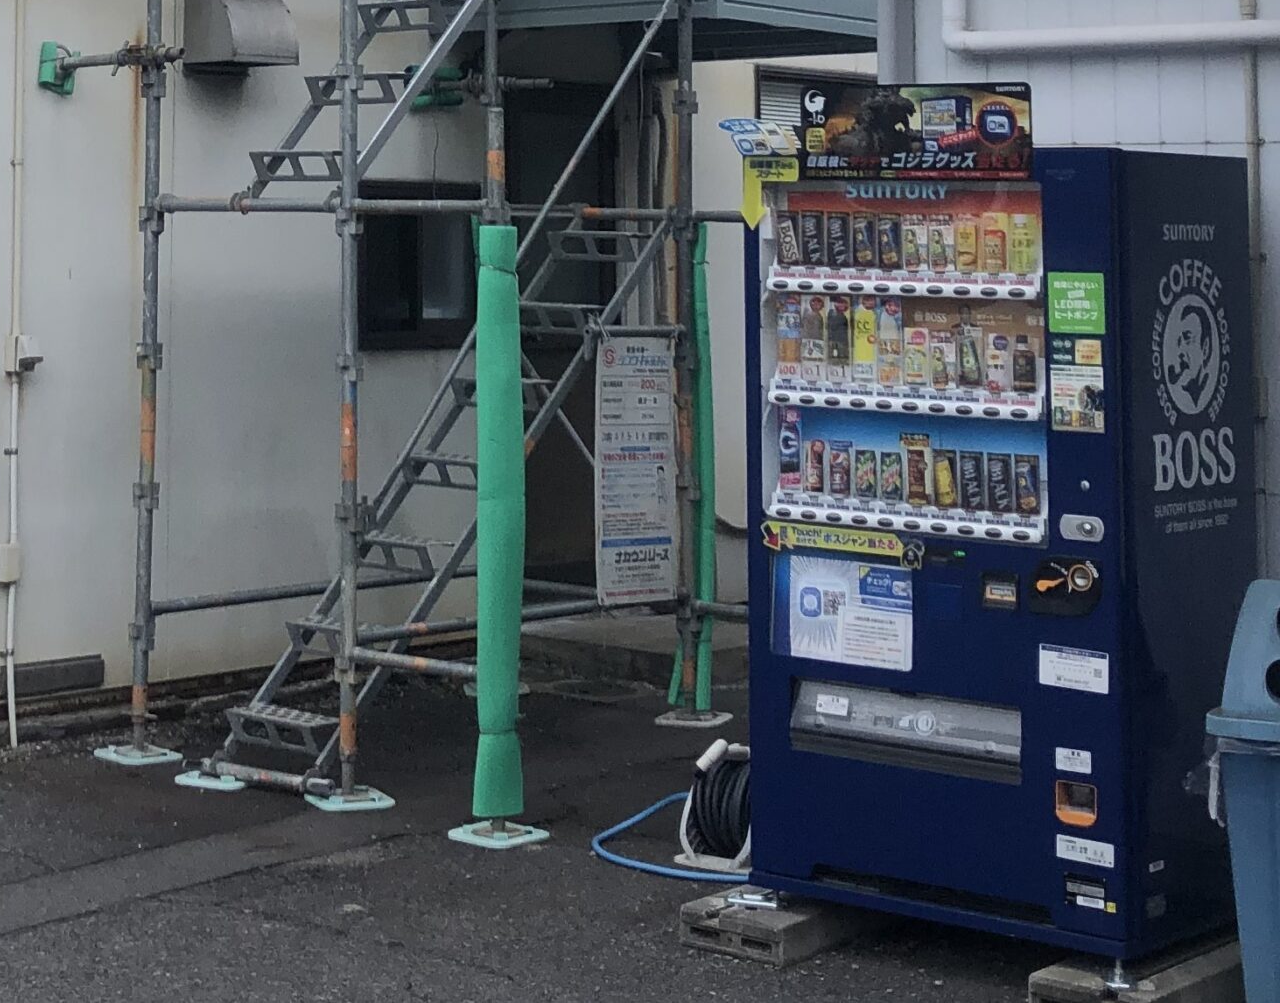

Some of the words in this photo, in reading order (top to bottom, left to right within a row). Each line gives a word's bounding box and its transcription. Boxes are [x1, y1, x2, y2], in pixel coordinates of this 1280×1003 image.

[845, 183, 948, 200] SUNTORY
[1162, 223, 1216, 242] SUNTORY
[779, 223, 799, 262] BOSS
[1159, 258, 1223, 306] COFFEE
[925, 311, 948, 323] BOSS
[1152, 307, 1166, 381] COFFEE
[1152, 426, 1236, 492] BOSS
[1154, 503, 1187, 518] SUNTORY
[790, 526, 820, 538] Touch!
